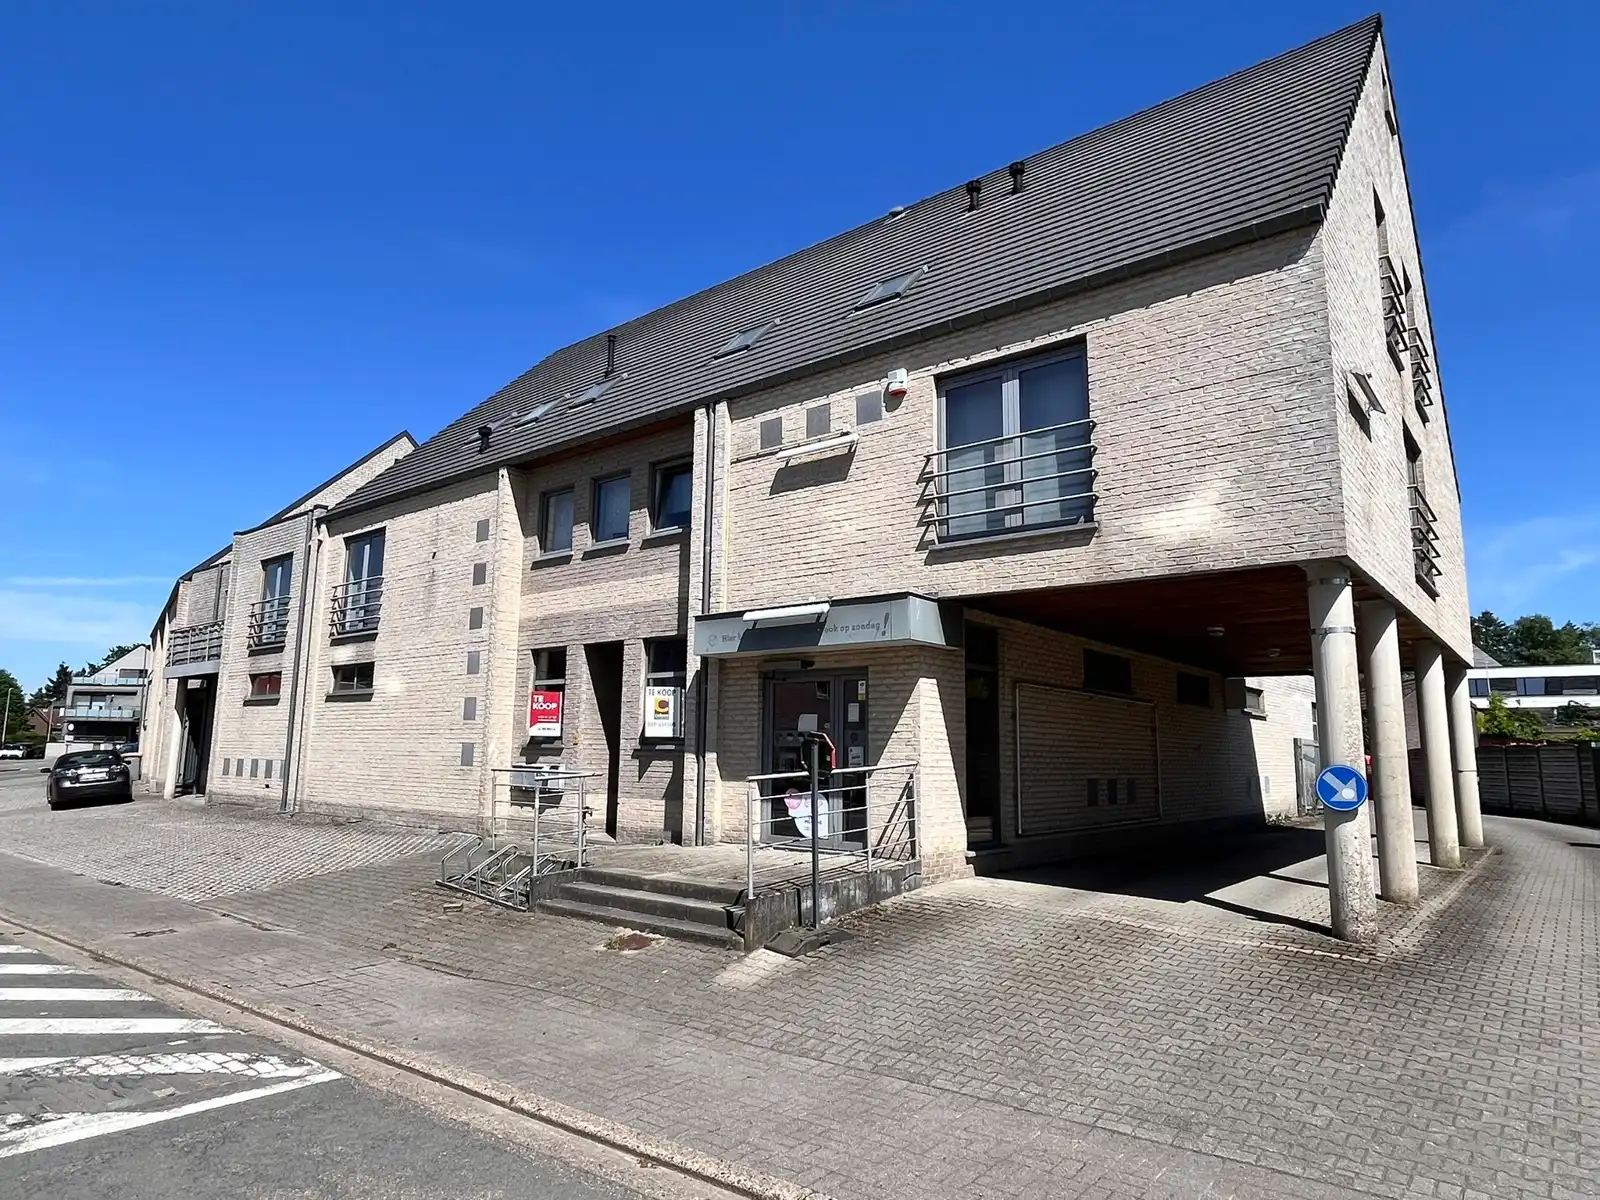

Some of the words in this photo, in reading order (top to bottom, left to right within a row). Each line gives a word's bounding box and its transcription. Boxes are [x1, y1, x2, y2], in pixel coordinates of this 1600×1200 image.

[824, 623, 839, 634] ook
[840, 626, 850, 634] op
[657, 688, 677, 696] KOOP
[532, 702, 557, 710] KOOP
